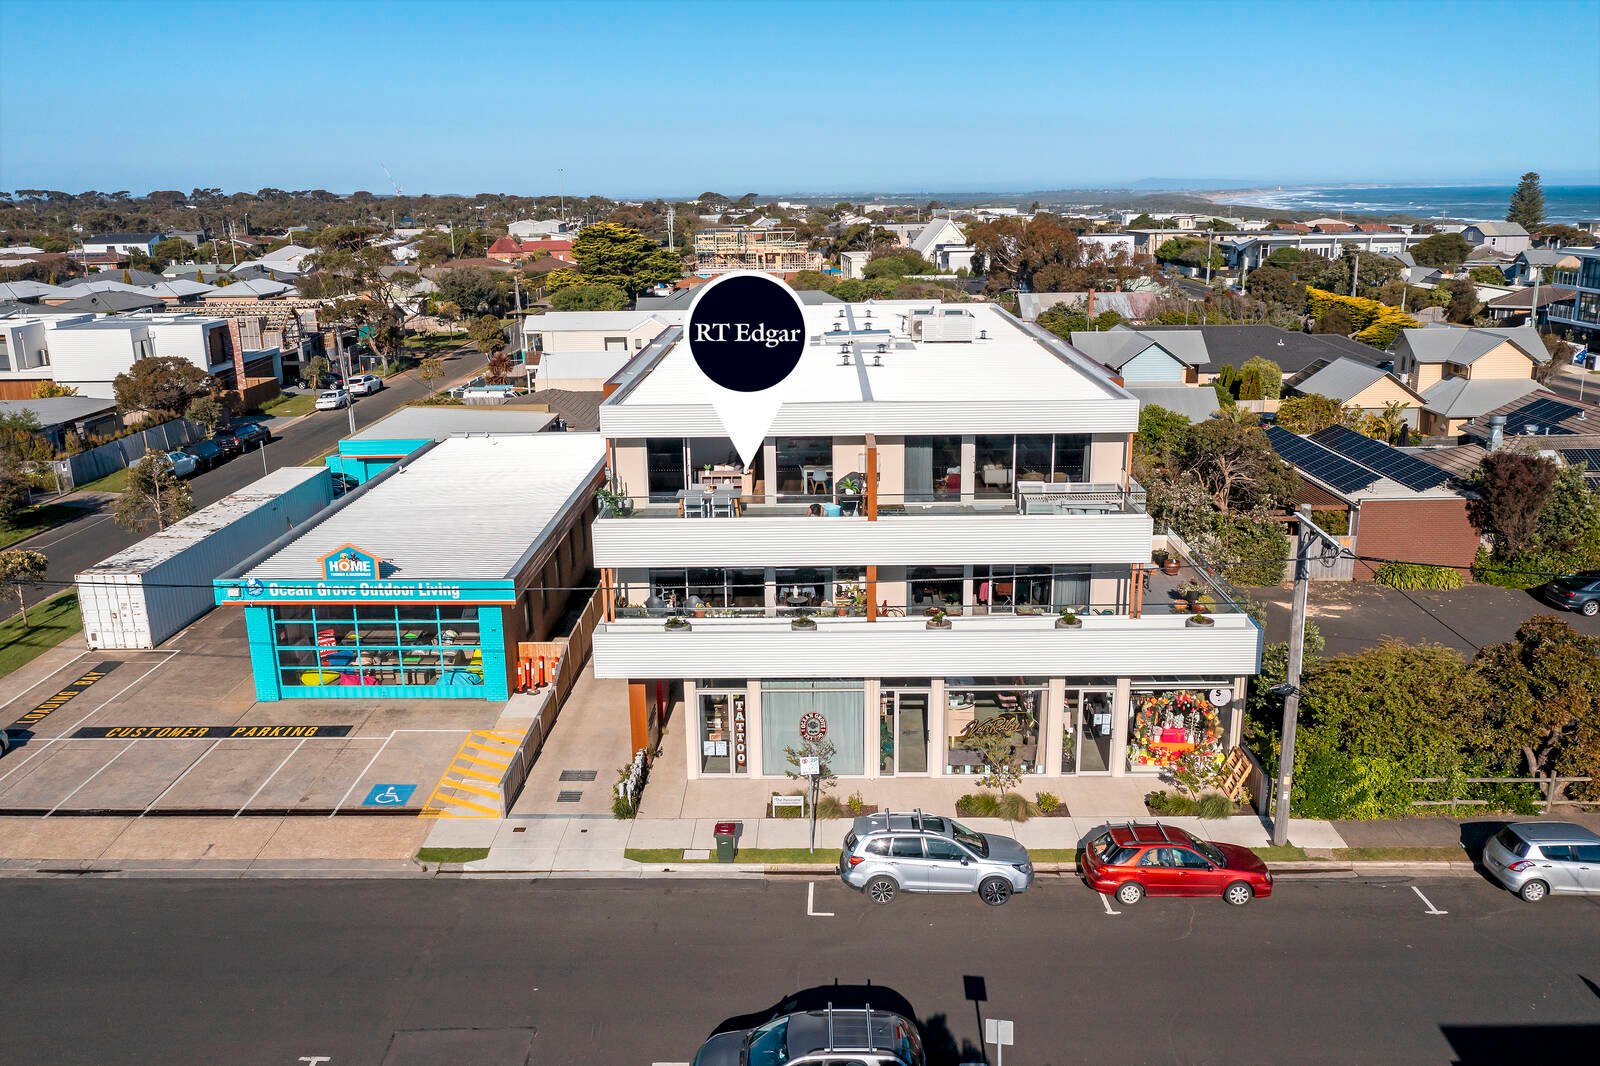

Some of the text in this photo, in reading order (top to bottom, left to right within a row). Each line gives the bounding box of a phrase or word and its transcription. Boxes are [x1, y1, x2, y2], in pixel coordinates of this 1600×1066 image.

[329, 560, 371, 572] HOME
[269, 582, 460, 599] Ocean Grove Outdoor Living
[15, 671, 106, 725] LOADING BAY
[105, 726, 319, 738] CUSTOMER PARKING
[734, 700, 746, 765] TATTOO
